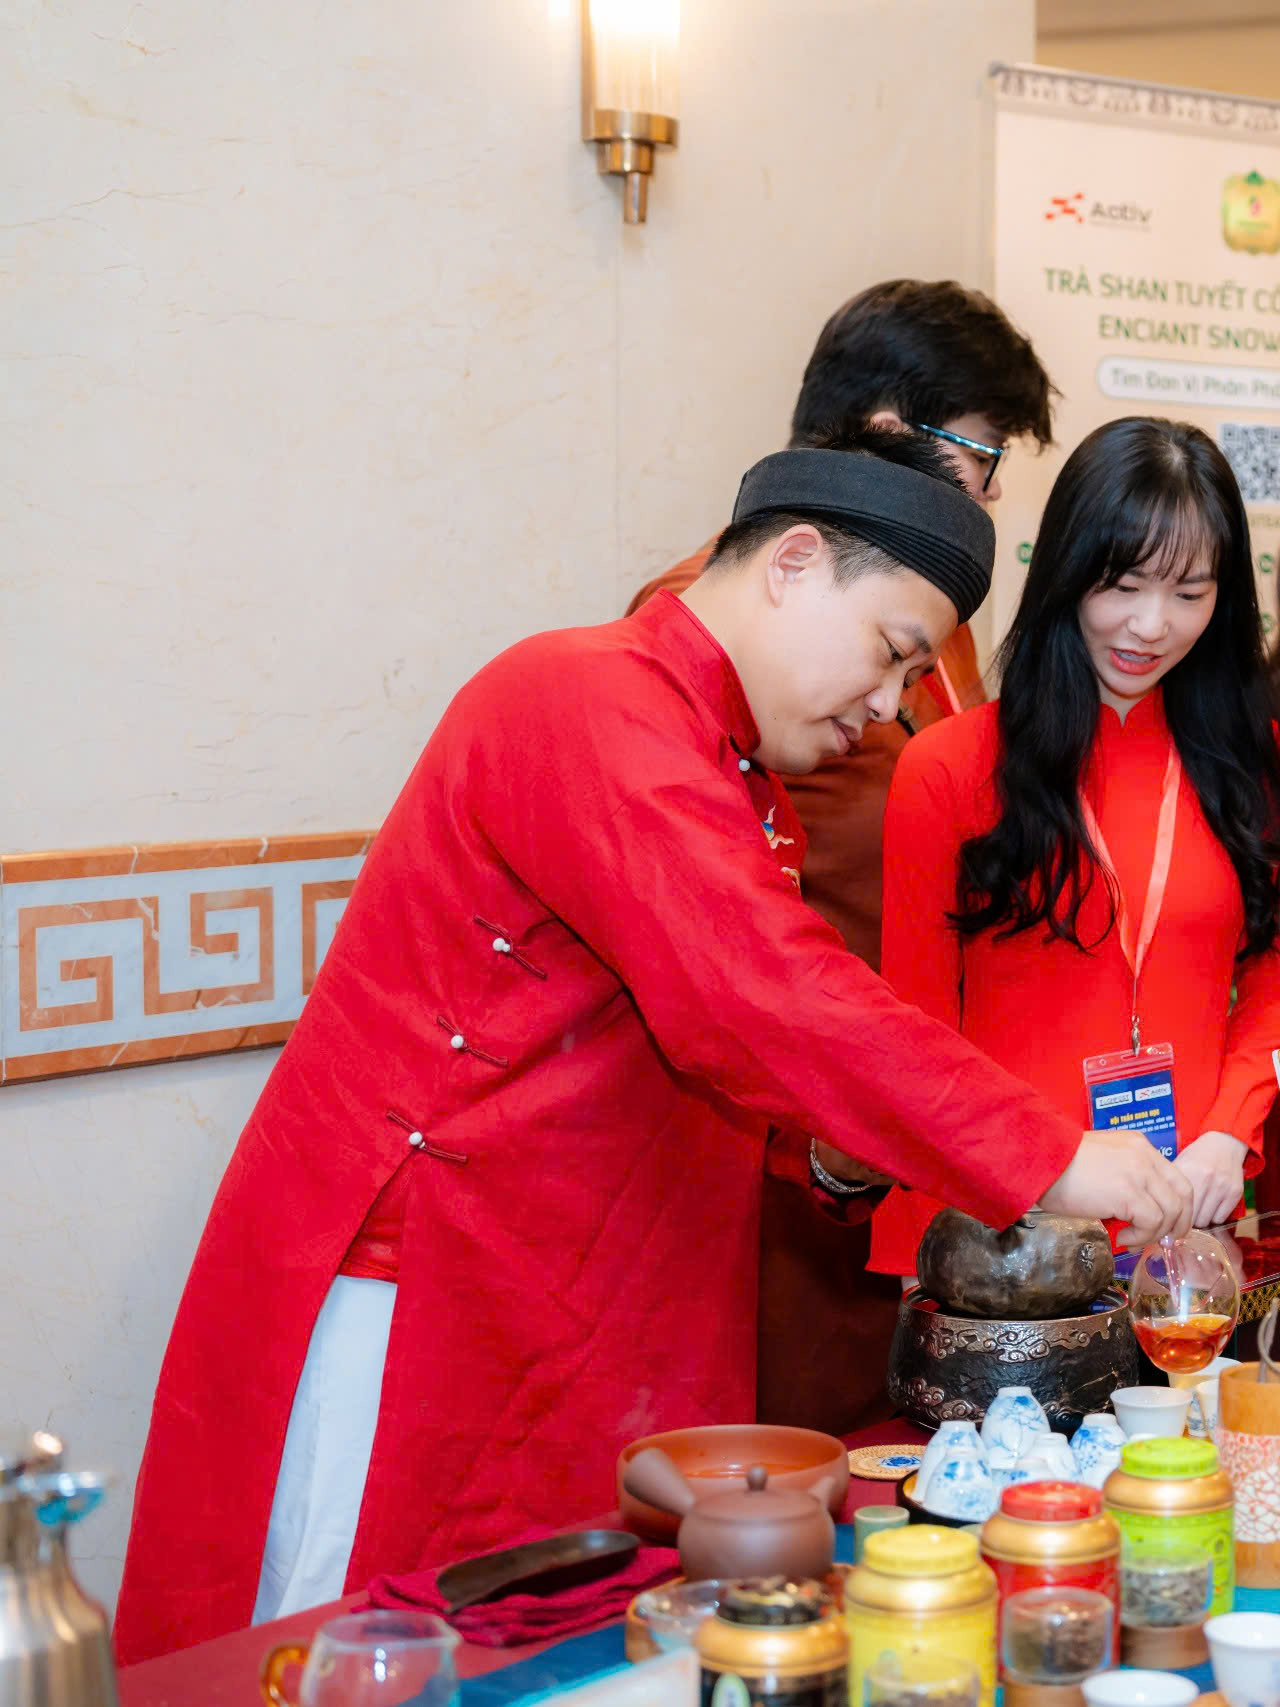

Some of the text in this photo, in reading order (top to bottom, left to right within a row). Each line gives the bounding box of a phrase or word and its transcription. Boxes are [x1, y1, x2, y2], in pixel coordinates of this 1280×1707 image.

[1090, 201, 1153, 223] Activ
[1044, 264, 1092, 296] TRÀ
[1099, 272, 1168, 302] SHAN
[1175, 279, 1247, 311] TUYẾT
[1098, 313, 1201, 345] ENCIANT
